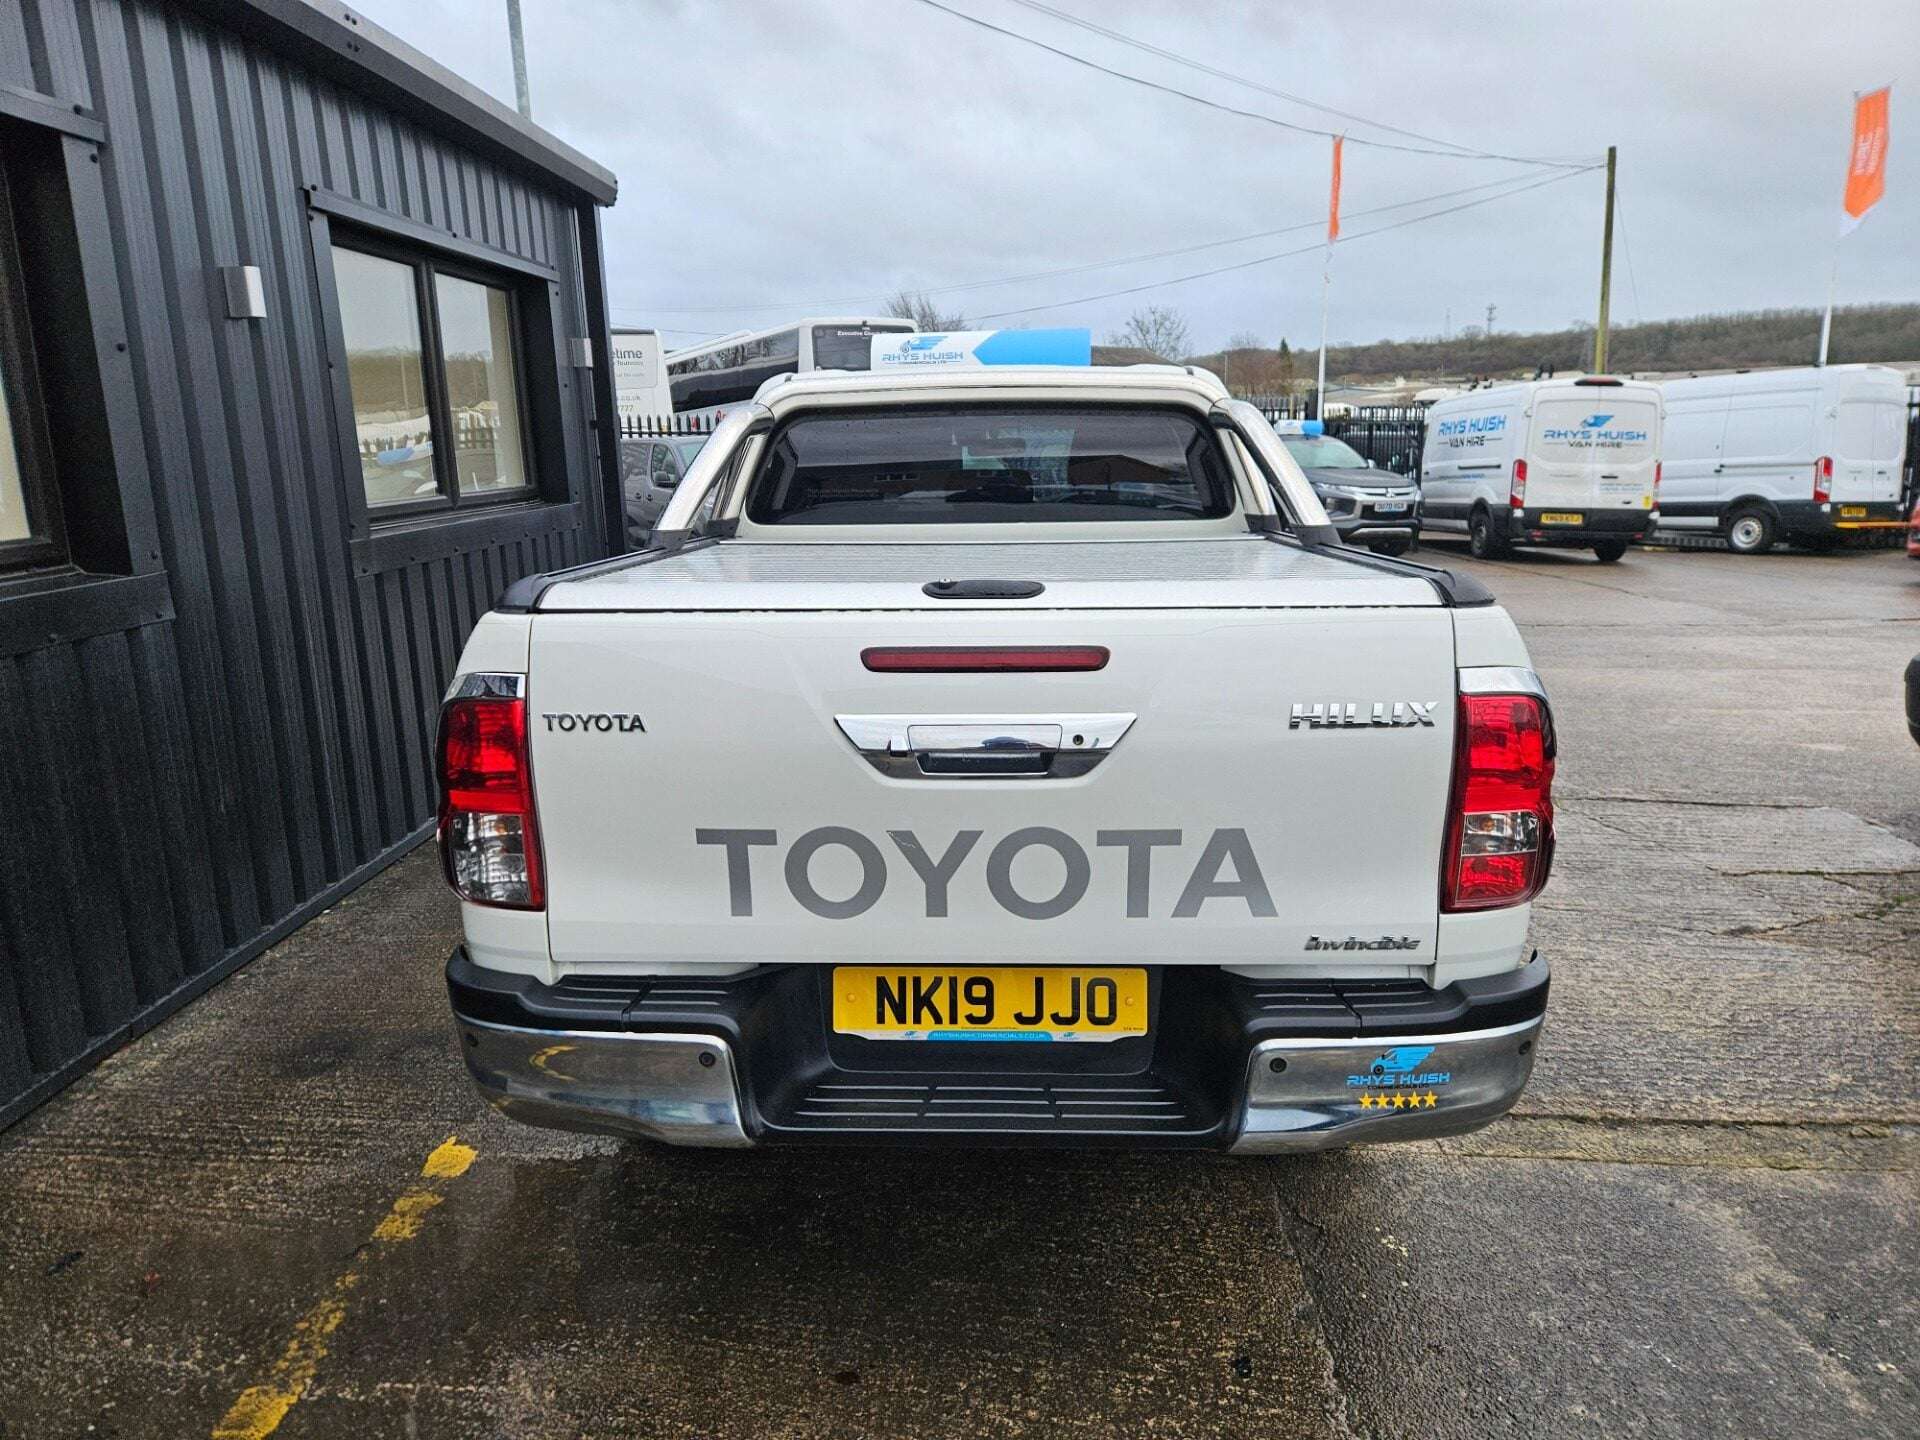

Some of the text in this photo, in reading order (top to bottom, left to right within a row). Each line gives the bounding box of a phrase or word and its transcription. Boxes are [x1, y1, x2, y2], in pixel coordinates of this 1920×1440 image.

[882, 351, 964, 361] RHYS HUISH
[1439, 415, 1507, 436] RHYS HUISH
[1449, 435, 1486, 448] VAN HIRE
[1543, 430, 1647, 440] RHYS HUISH
[1595, 441, 1623, 449] HIRE
[542, 713, 646, 733] TOYOTA
[1289, 702, 1439, 730] HILUX
[695, 826, 1279, 920] TOYOTA
[876, 975, 1117, 1026] NK19 JJO
[1346, 1071, 1451, 1087] RHYS HUISH
